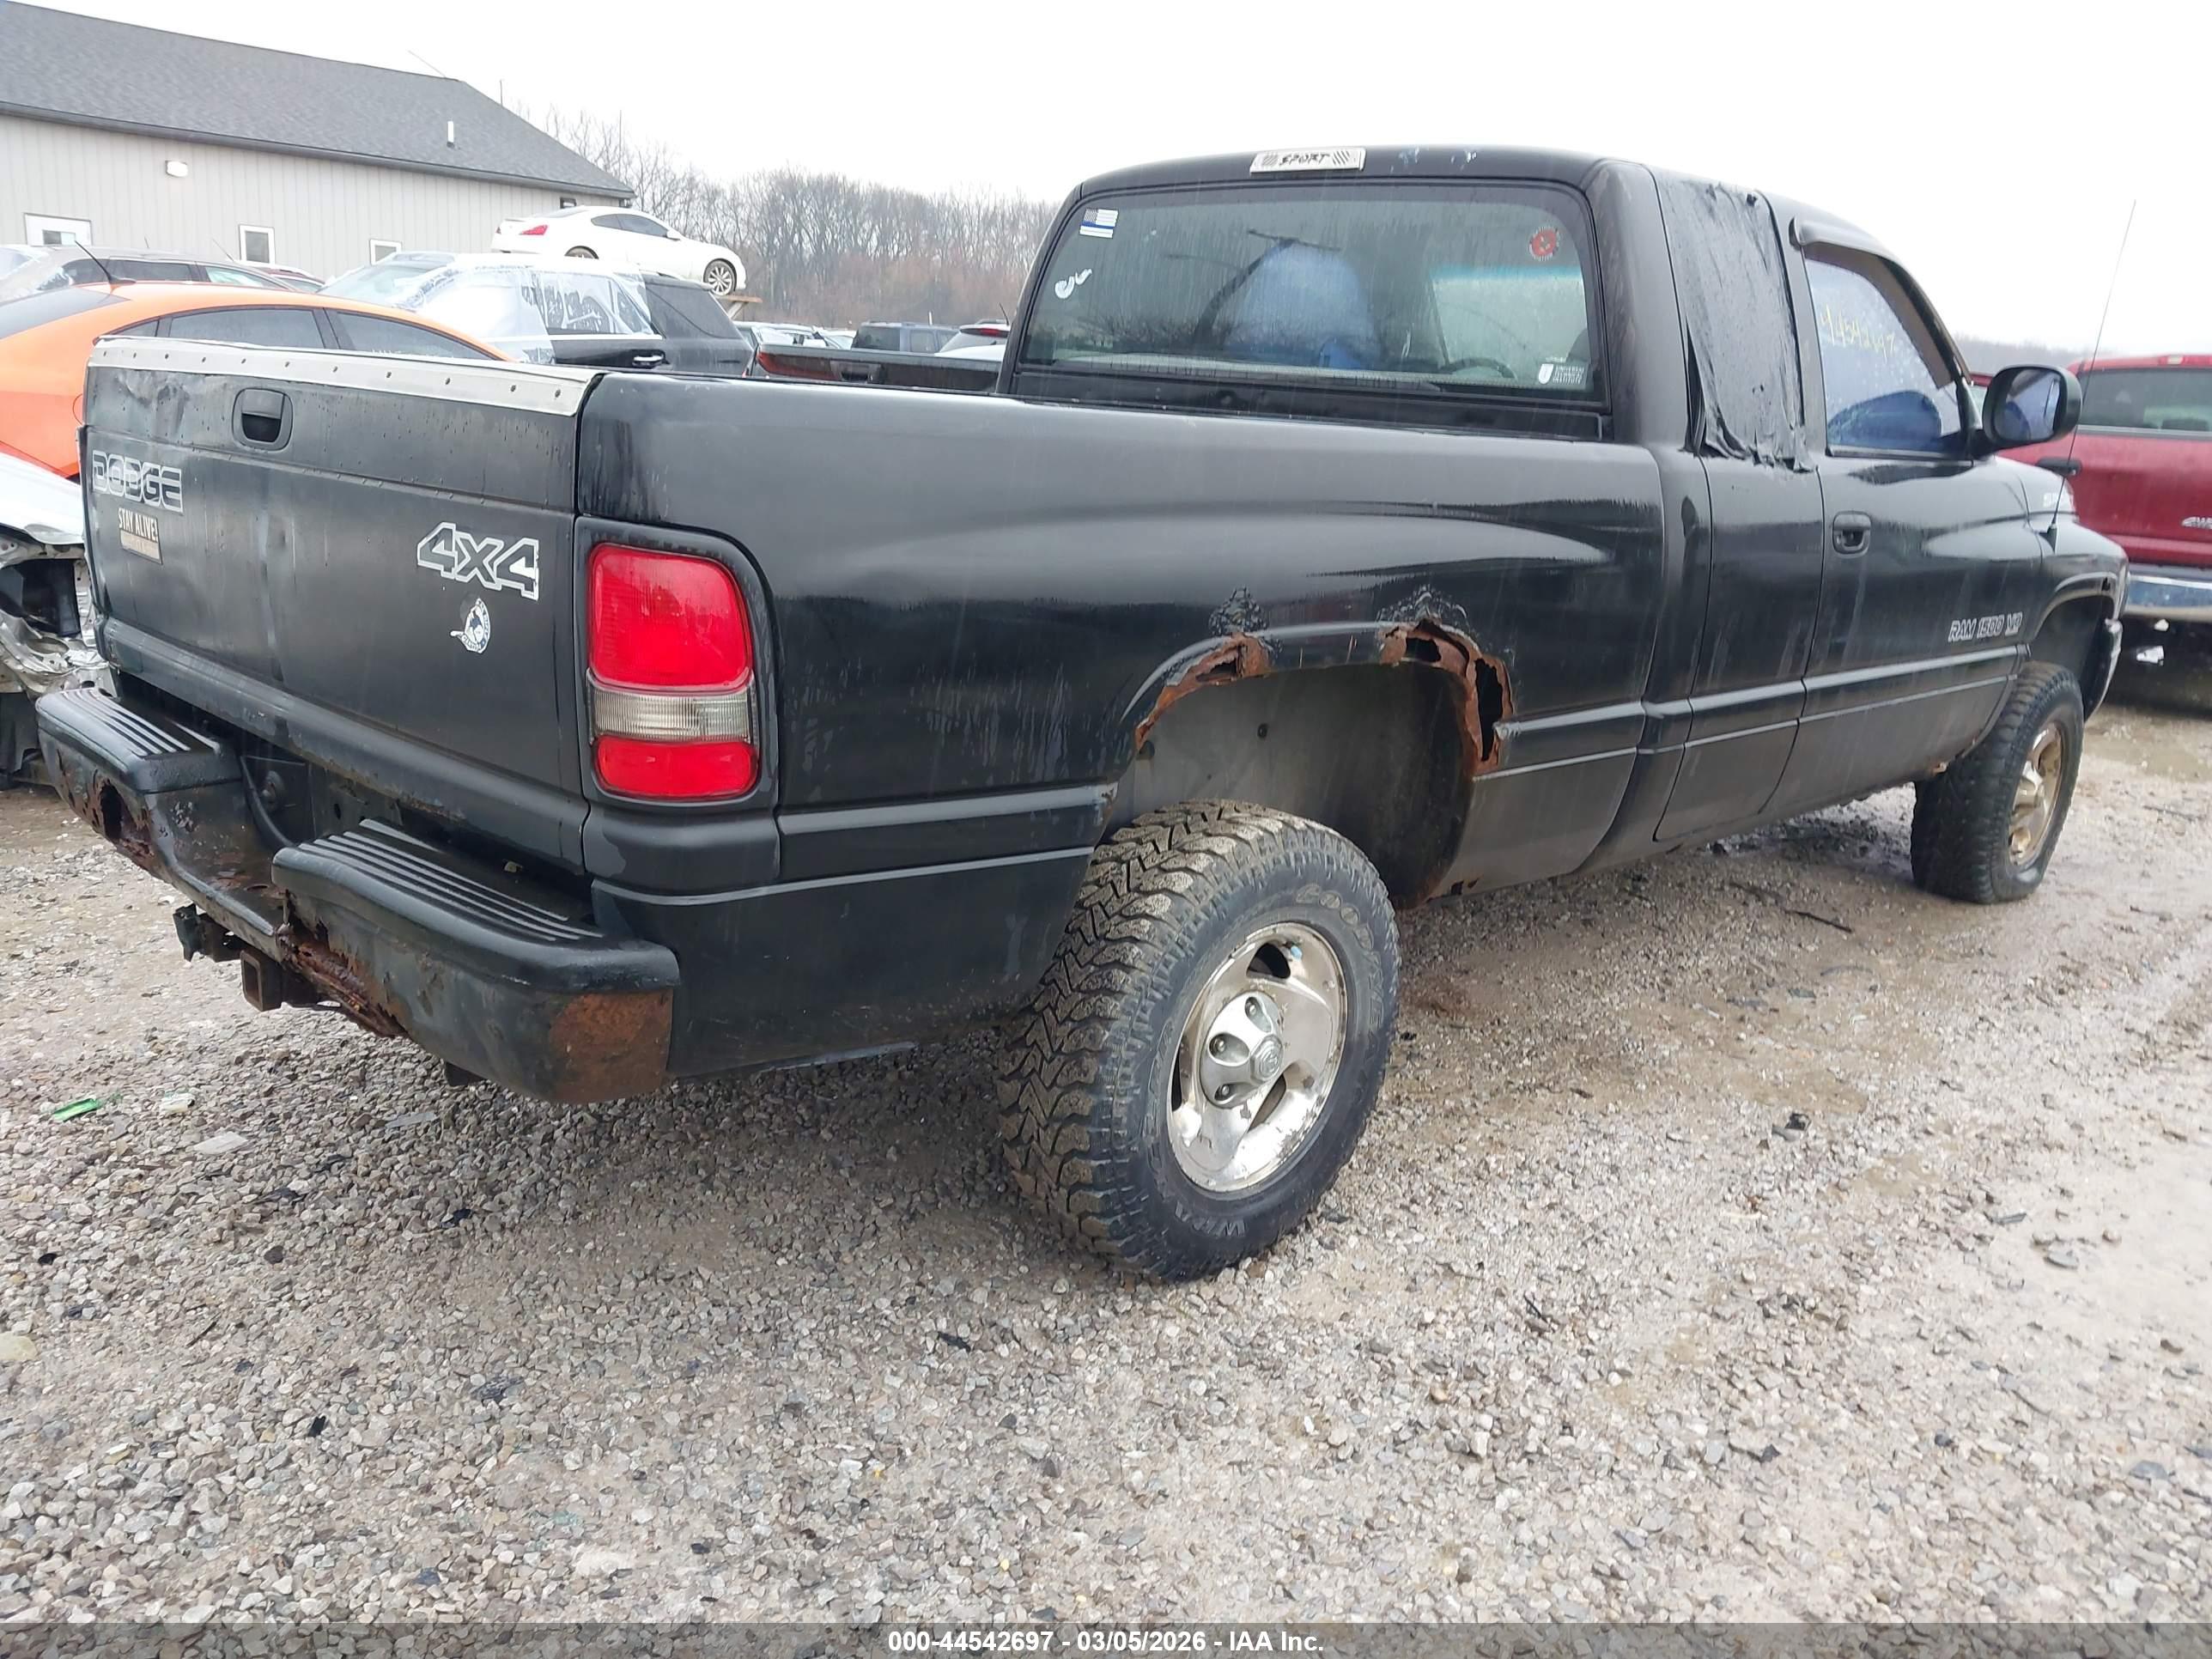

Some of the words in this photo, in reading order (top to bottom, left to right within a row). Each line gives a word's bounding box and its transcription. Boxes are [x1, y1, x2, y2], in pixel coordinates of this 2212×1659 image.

[1279, 153, 1330, 167] SPORT
[92, 449, 184, 514] DODGE
[118, 507, 133, 533] STAY
[1948, 617, 1978, 643] RAM
[1976, 614, 2005, 639] 1500
